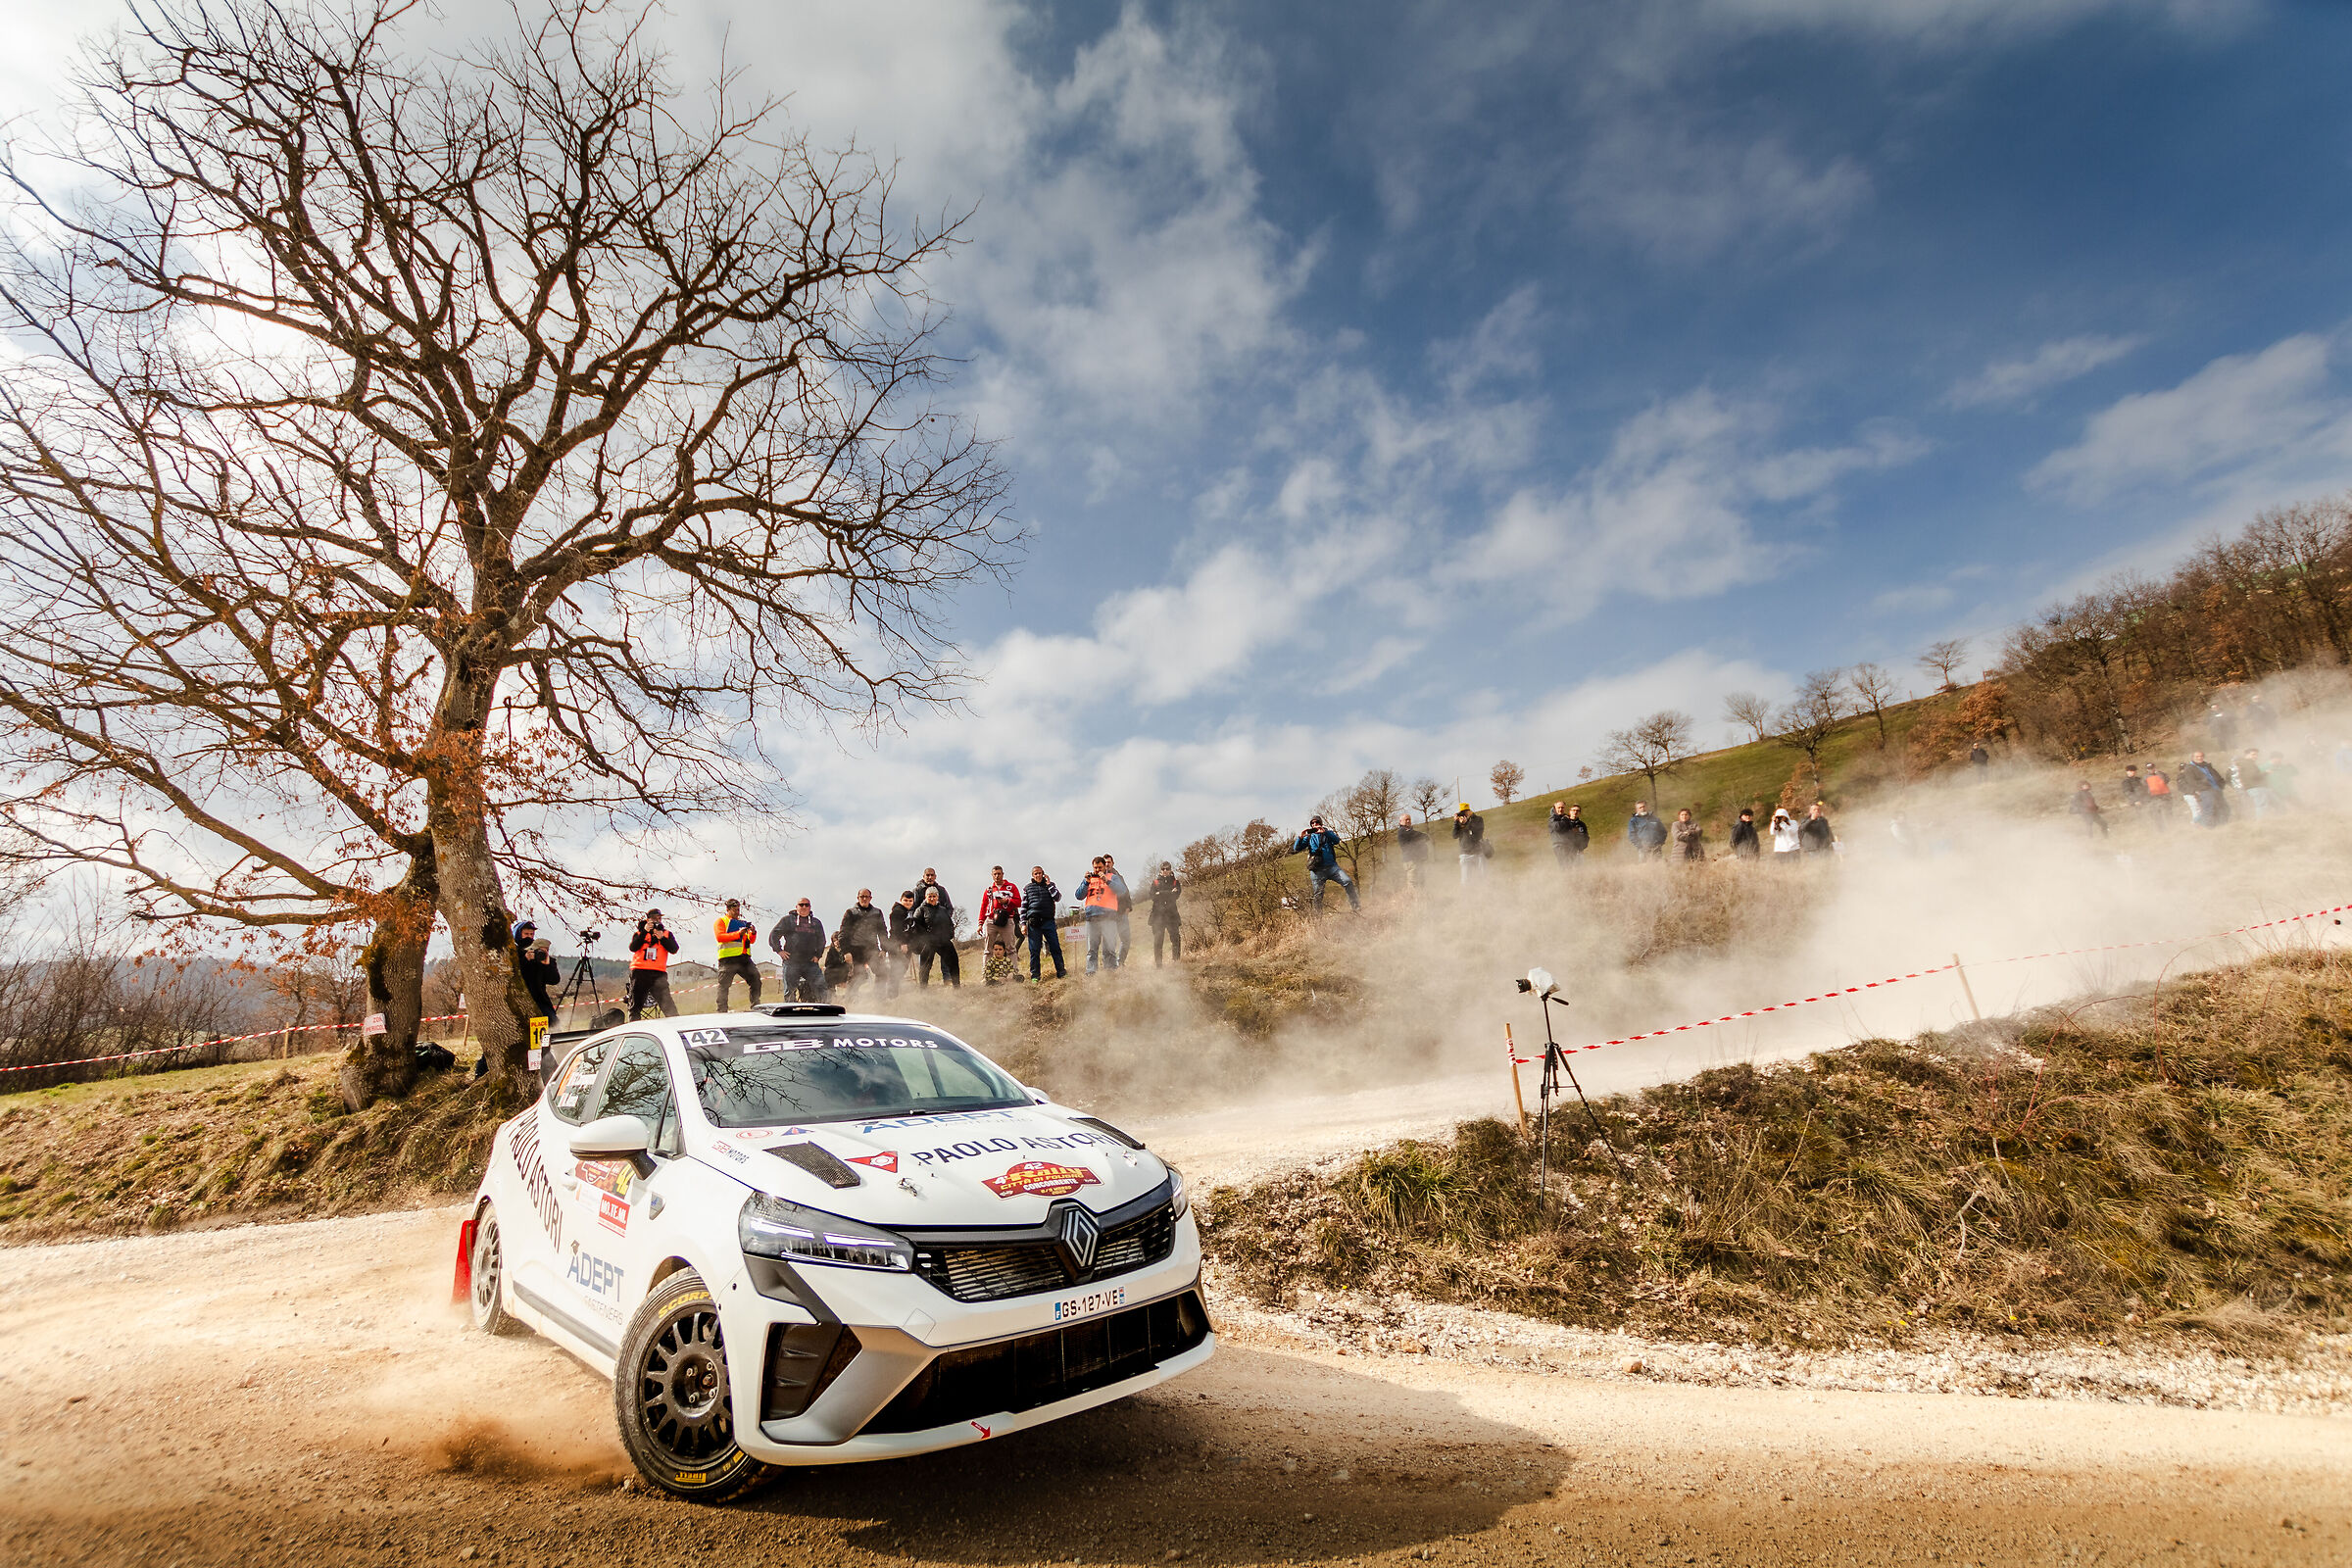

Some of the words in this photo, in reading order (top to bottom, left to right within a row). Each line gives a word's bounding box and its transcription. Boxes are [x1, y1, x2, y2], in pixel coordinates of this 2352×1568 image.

[690, 1029, 725, 1045] 42
[833, 1038, 938, 1049] MOTORS
[862, 1110, 1014, 1134] ADEPT
[909, 1138, 1018, 1165] PAOLO
[1019, 1132, 1122, 1149] ASTORI
[1023, 1178, 1078, 1191] CONCORRENTE
[567, 1251, 624, 1302] ADEPT
[1061, 1289, 1118, 1318] GS-127-VE
